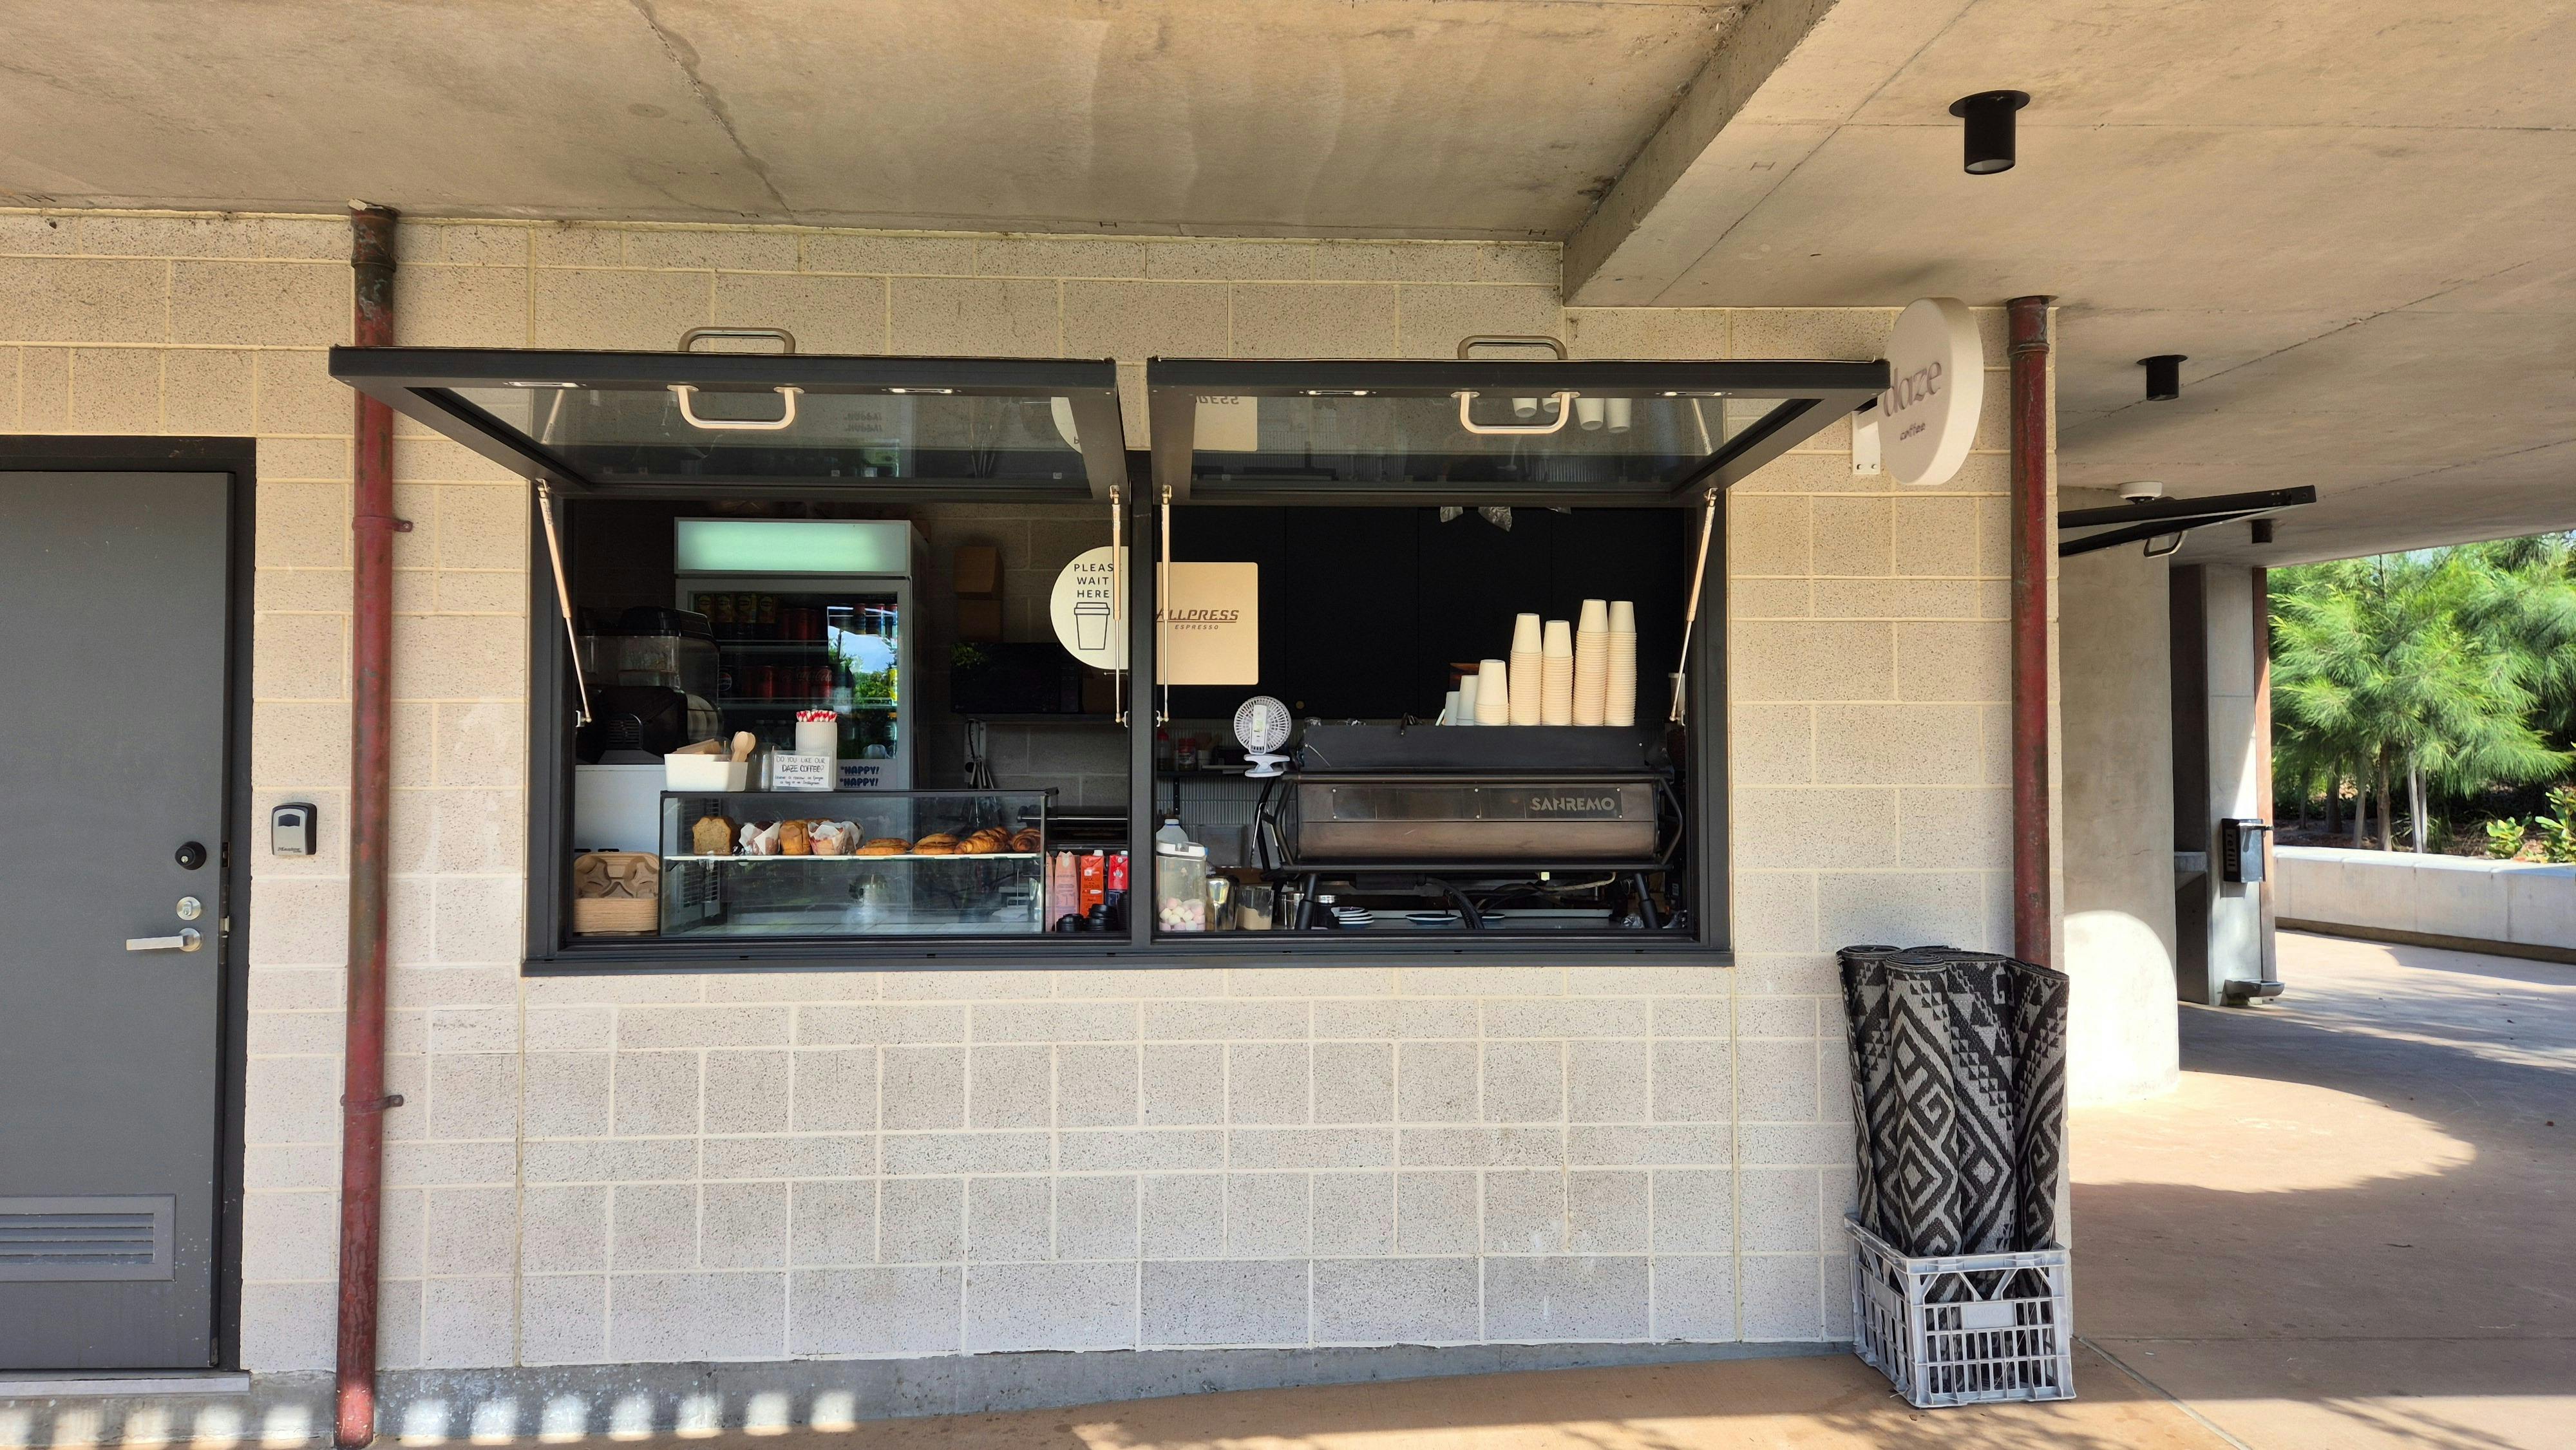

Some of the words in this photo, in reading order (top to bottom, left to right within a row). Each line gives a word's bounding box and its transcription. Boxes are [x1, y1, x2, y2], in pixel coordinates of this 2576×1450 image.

[1884, 362, 1942, 417] daze
[1900, 422, 1926, 441] coffee
[1074, 563, 1122, 572] PLEAS
[1077, 576, 1110, 585] WAIT
[1077, 589, 1110, 598] HERE
[782, 764, 799, 773] DAZE
[1530, 797, 1615, 811] SANREMO
[2227, 833, 2236, 867] refill
